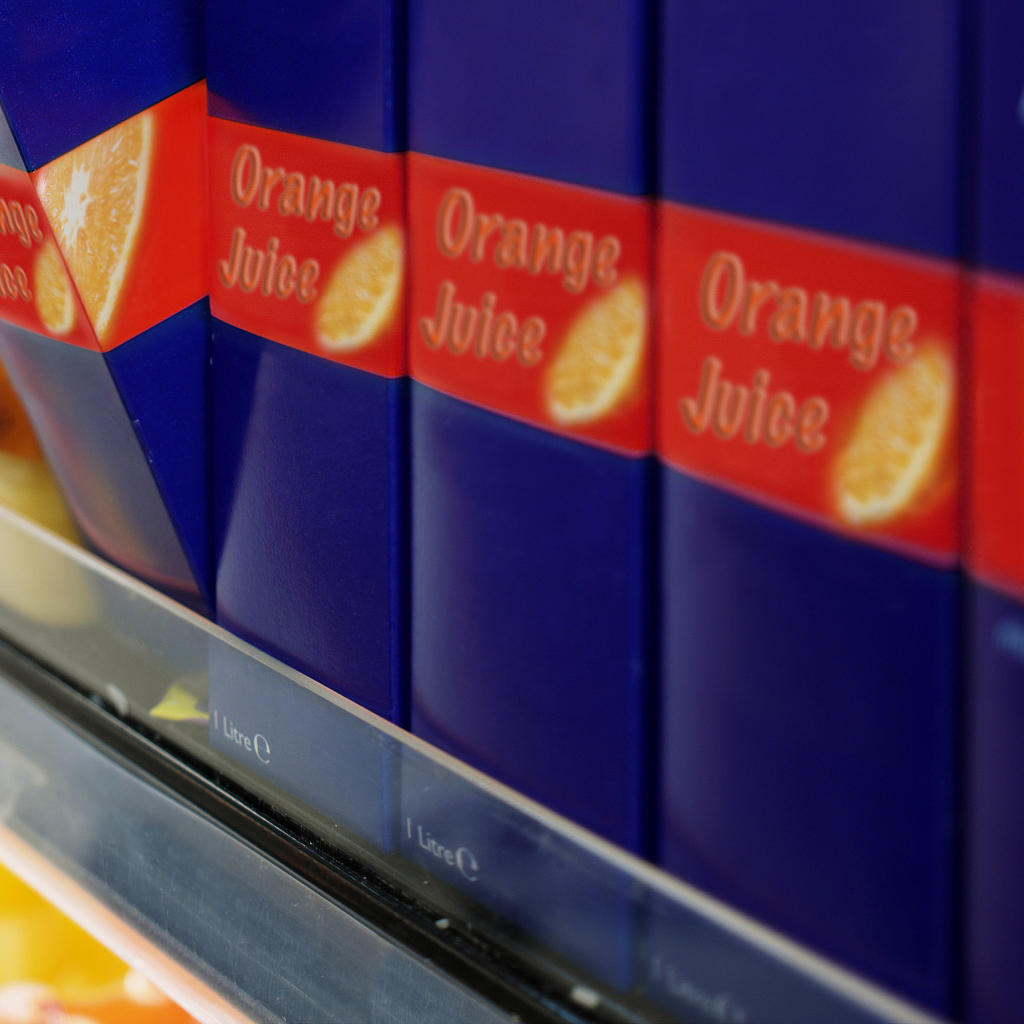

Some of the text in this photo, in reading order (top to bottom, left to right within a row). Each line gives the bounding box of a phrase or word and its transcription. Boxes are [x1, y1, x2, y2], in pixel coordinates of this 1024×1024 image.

[231, 143, 382, 239] Orange
[218, 227, 320, 304] Juice
[437, 187, 621, 295] Orange
[419, 280, 546, 368] Juice
[700, 250, 918, 372] Orange
[680, 354, 830, 454] Juice
[222, 716, 252, 752] Litre
[417, 824, 455, 866] Litre
